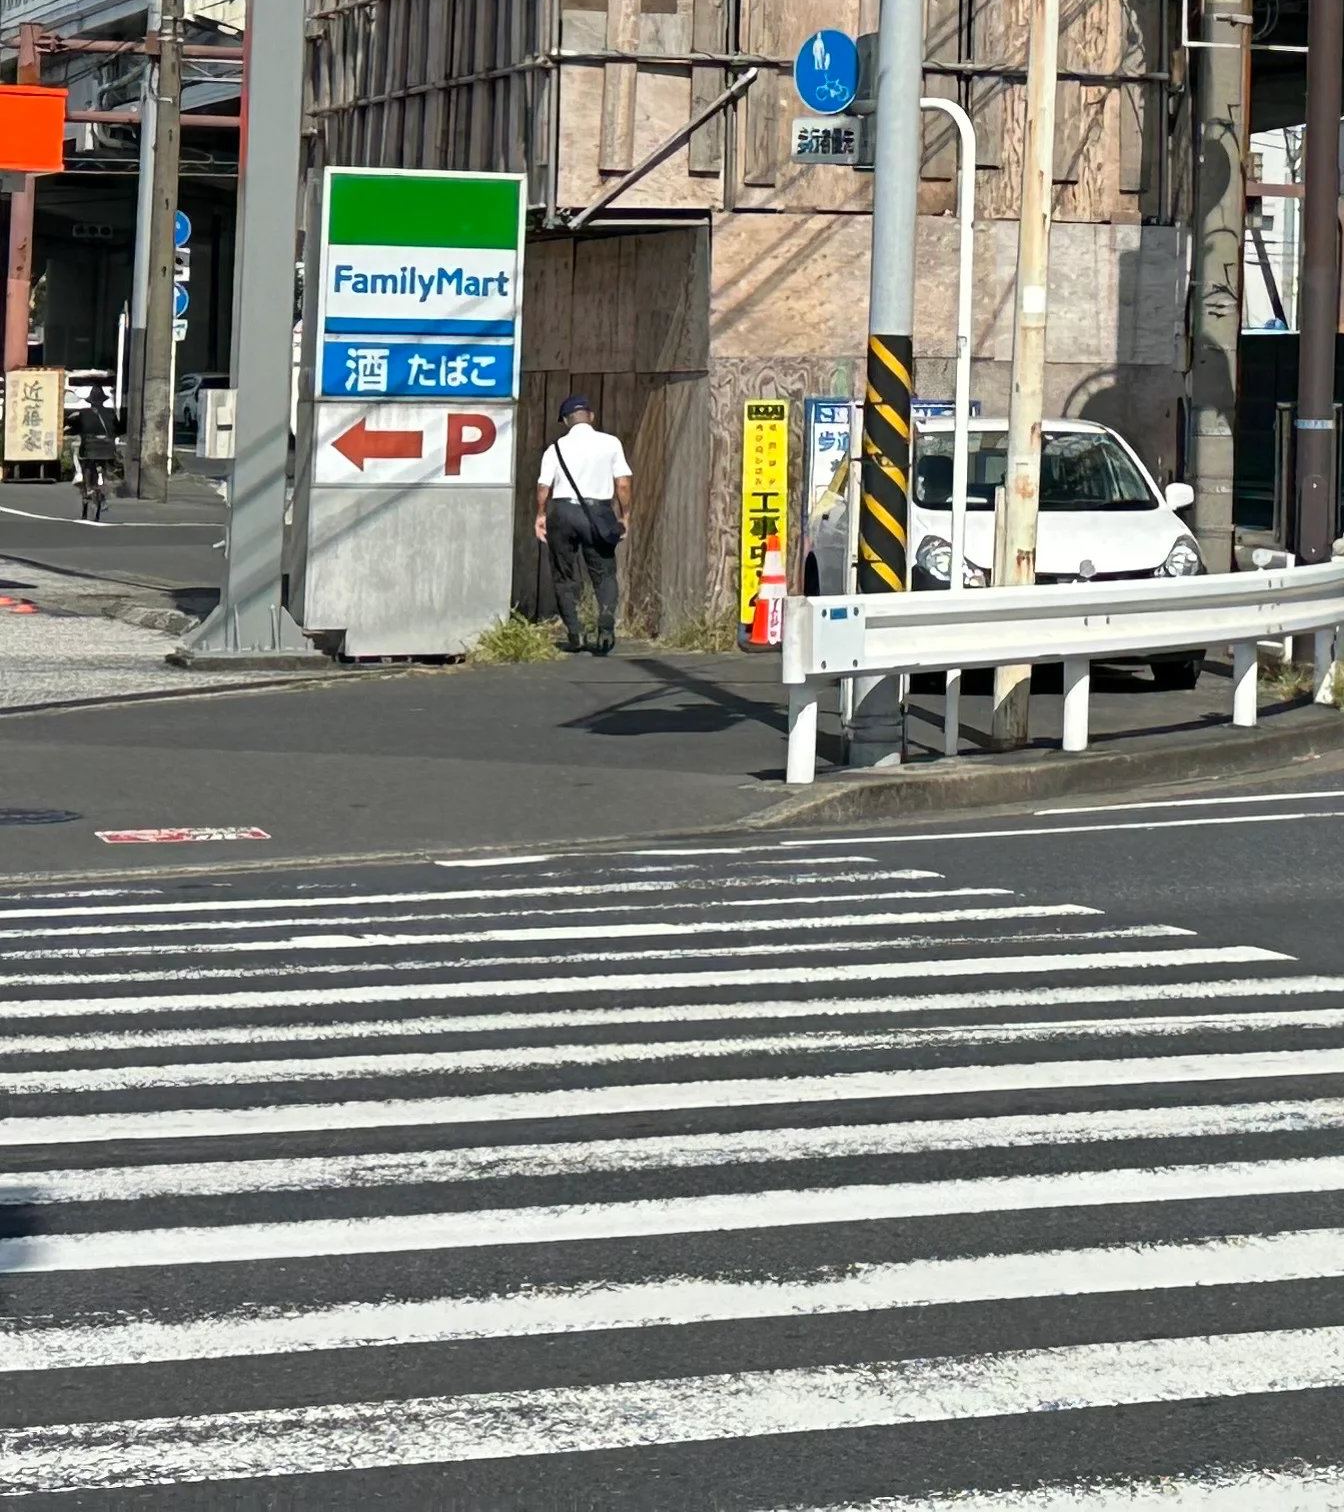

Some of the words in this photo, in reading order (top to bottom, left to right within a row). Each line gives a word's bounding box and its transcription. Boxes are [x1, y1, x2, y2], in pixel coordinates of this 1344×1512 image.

[334, 265, 510, 303] FamilyMart
[345, 348, 389, 393] 酒
[407, 354, 497, 388] たばこ
[444, 414, 497, 476] P
